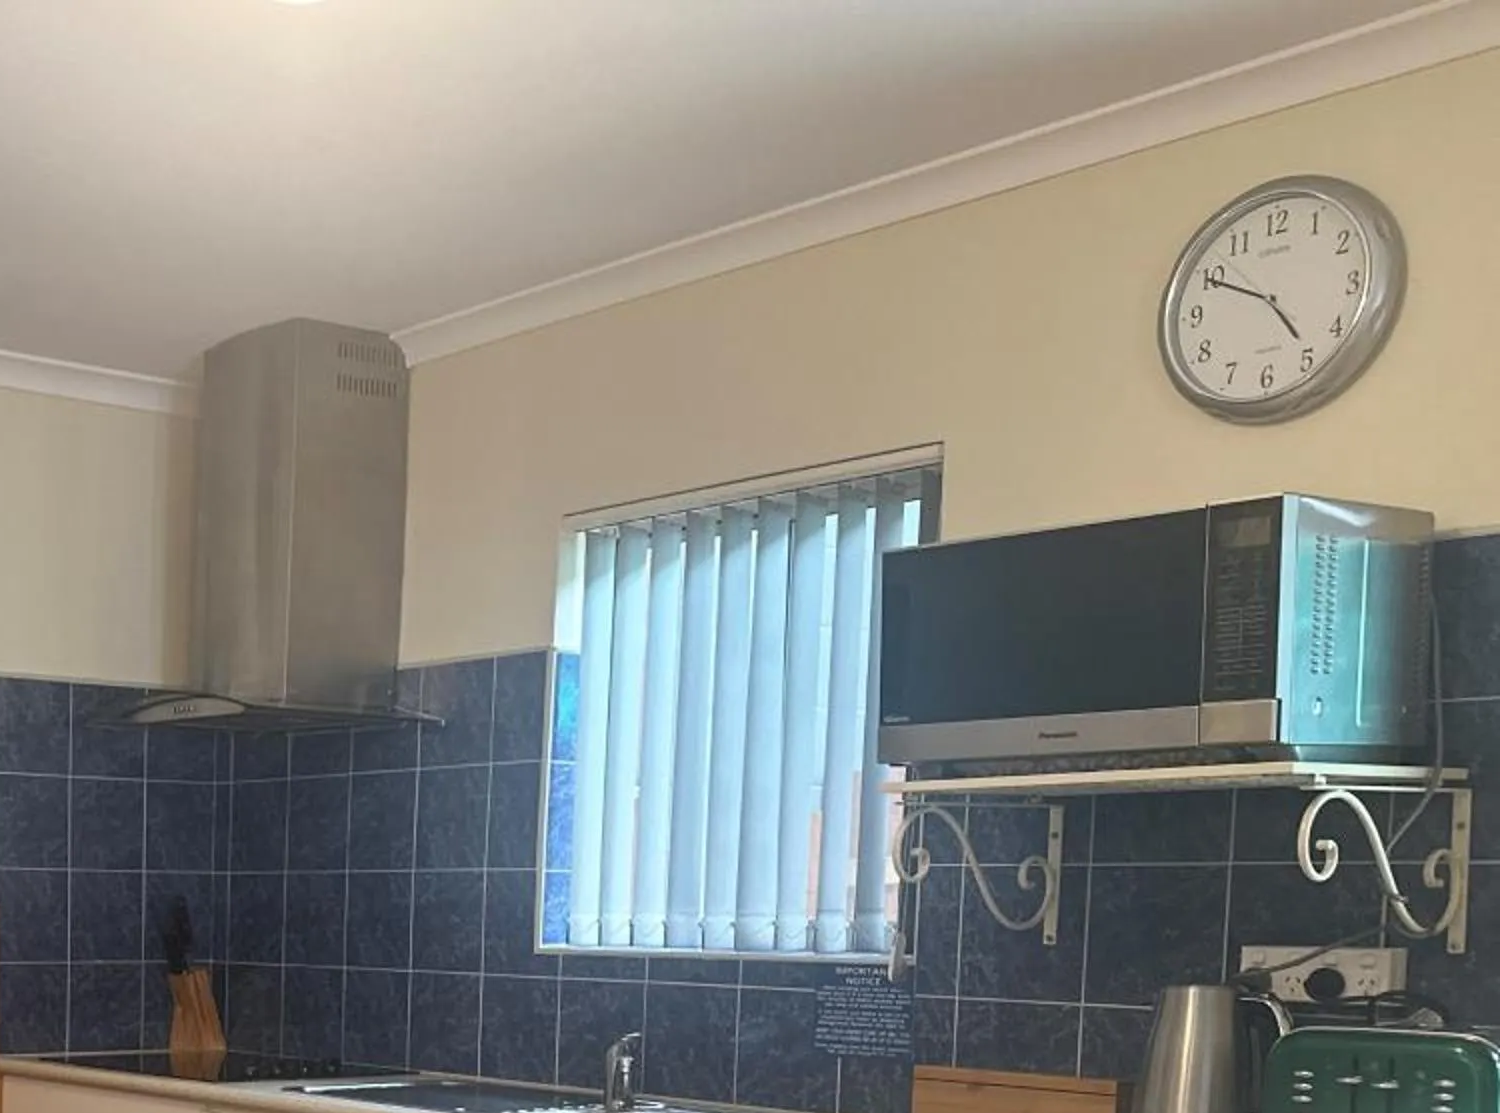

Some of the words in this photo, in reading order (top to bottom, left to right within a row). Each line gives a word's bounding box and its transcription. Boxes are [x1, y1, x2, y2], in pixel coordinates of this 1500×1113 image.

[1266, 209, 1289, 237] 12
[1312, 211, 1320, 236] 1
[1230, 231, 1249, 257] 11
[1335, 230, 1350, 255] 2
[1203, 264, 1225, 291] 10
[1345, 270, 1360, 295] 3
[1190, 305, 1204, 329] 9
[1329, 315, 1343, 338] 4
[1197, 339, 1212, 363] 8
[1300, 348, 1314, 373] 5
[1225, 362, 1238, 385] 7
[1260, 364, 1274, 389] 6
